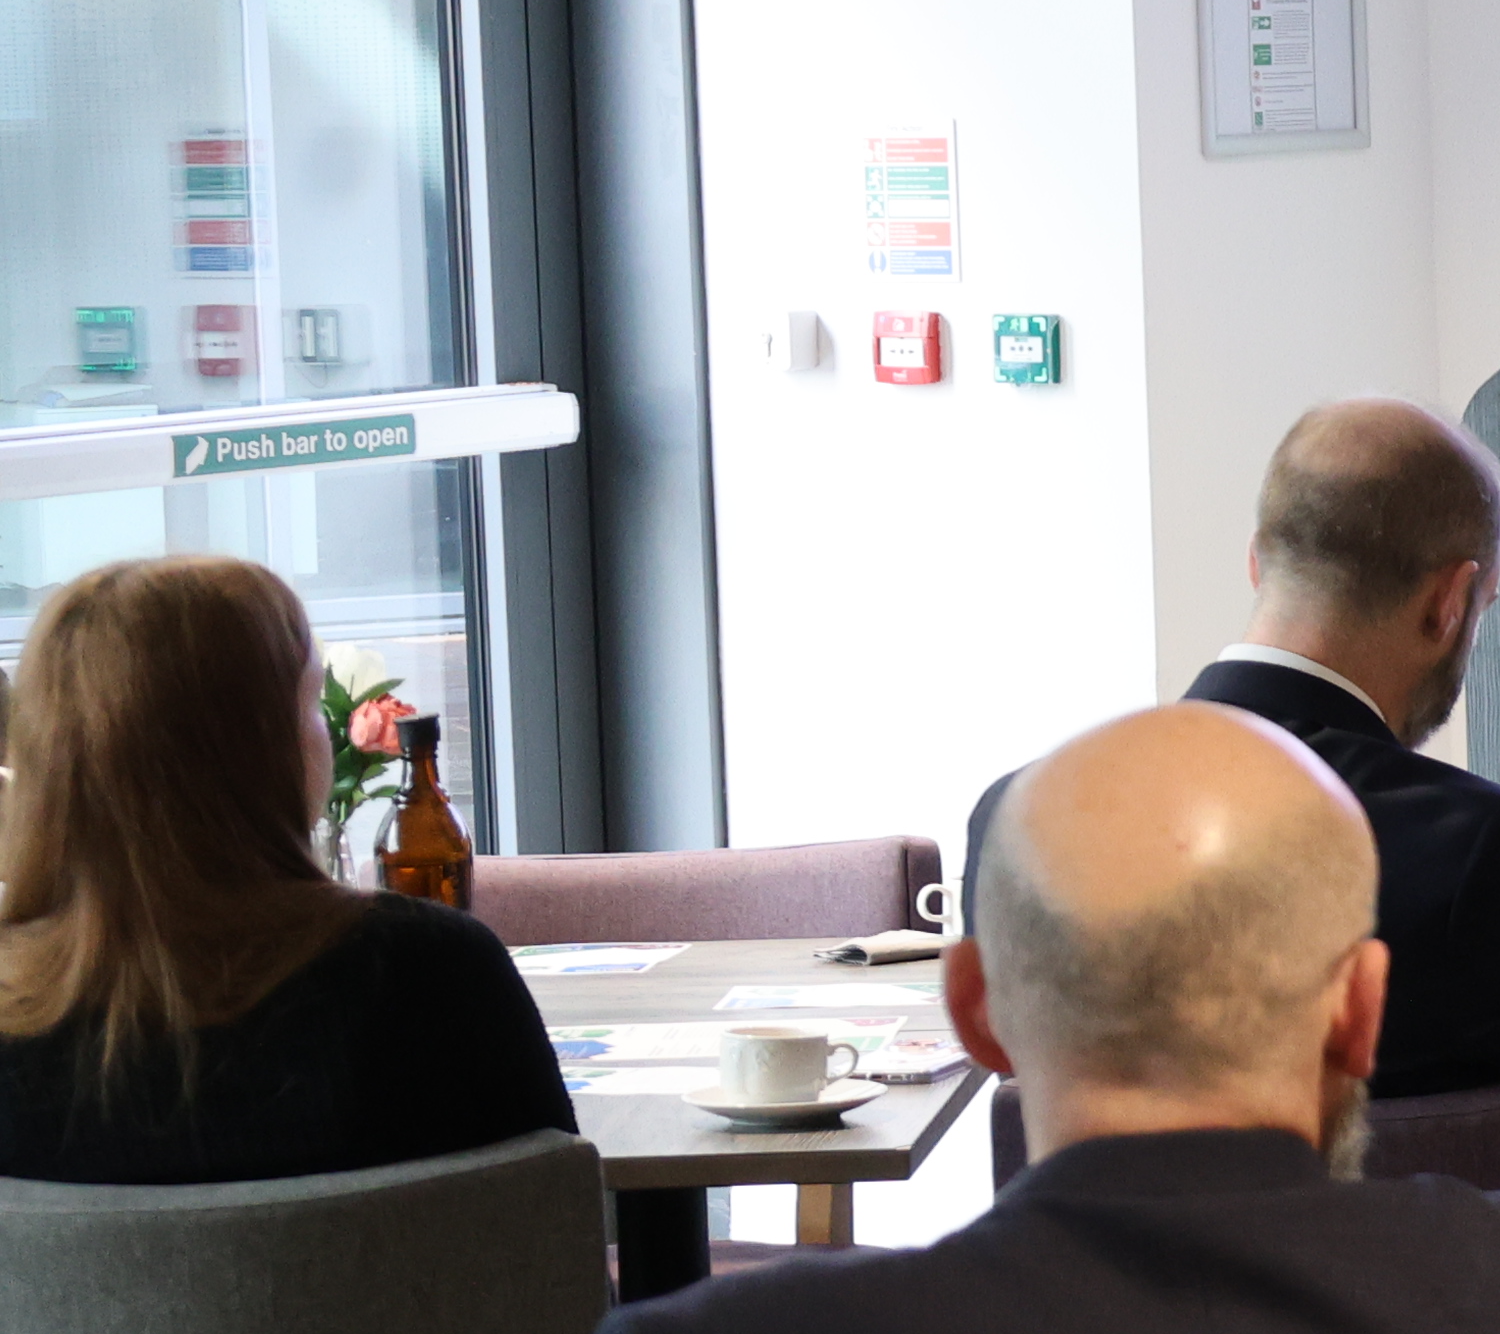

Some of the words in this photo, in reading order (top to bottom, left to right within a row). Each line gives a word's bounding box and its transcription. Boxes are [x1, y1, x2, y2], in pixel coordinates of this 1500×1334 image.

[216, 434, 275, 462] Push
[281, 432, 318, 456] bar
[324, 429, 347, 451] to
[353, 426, 408, 453] open
